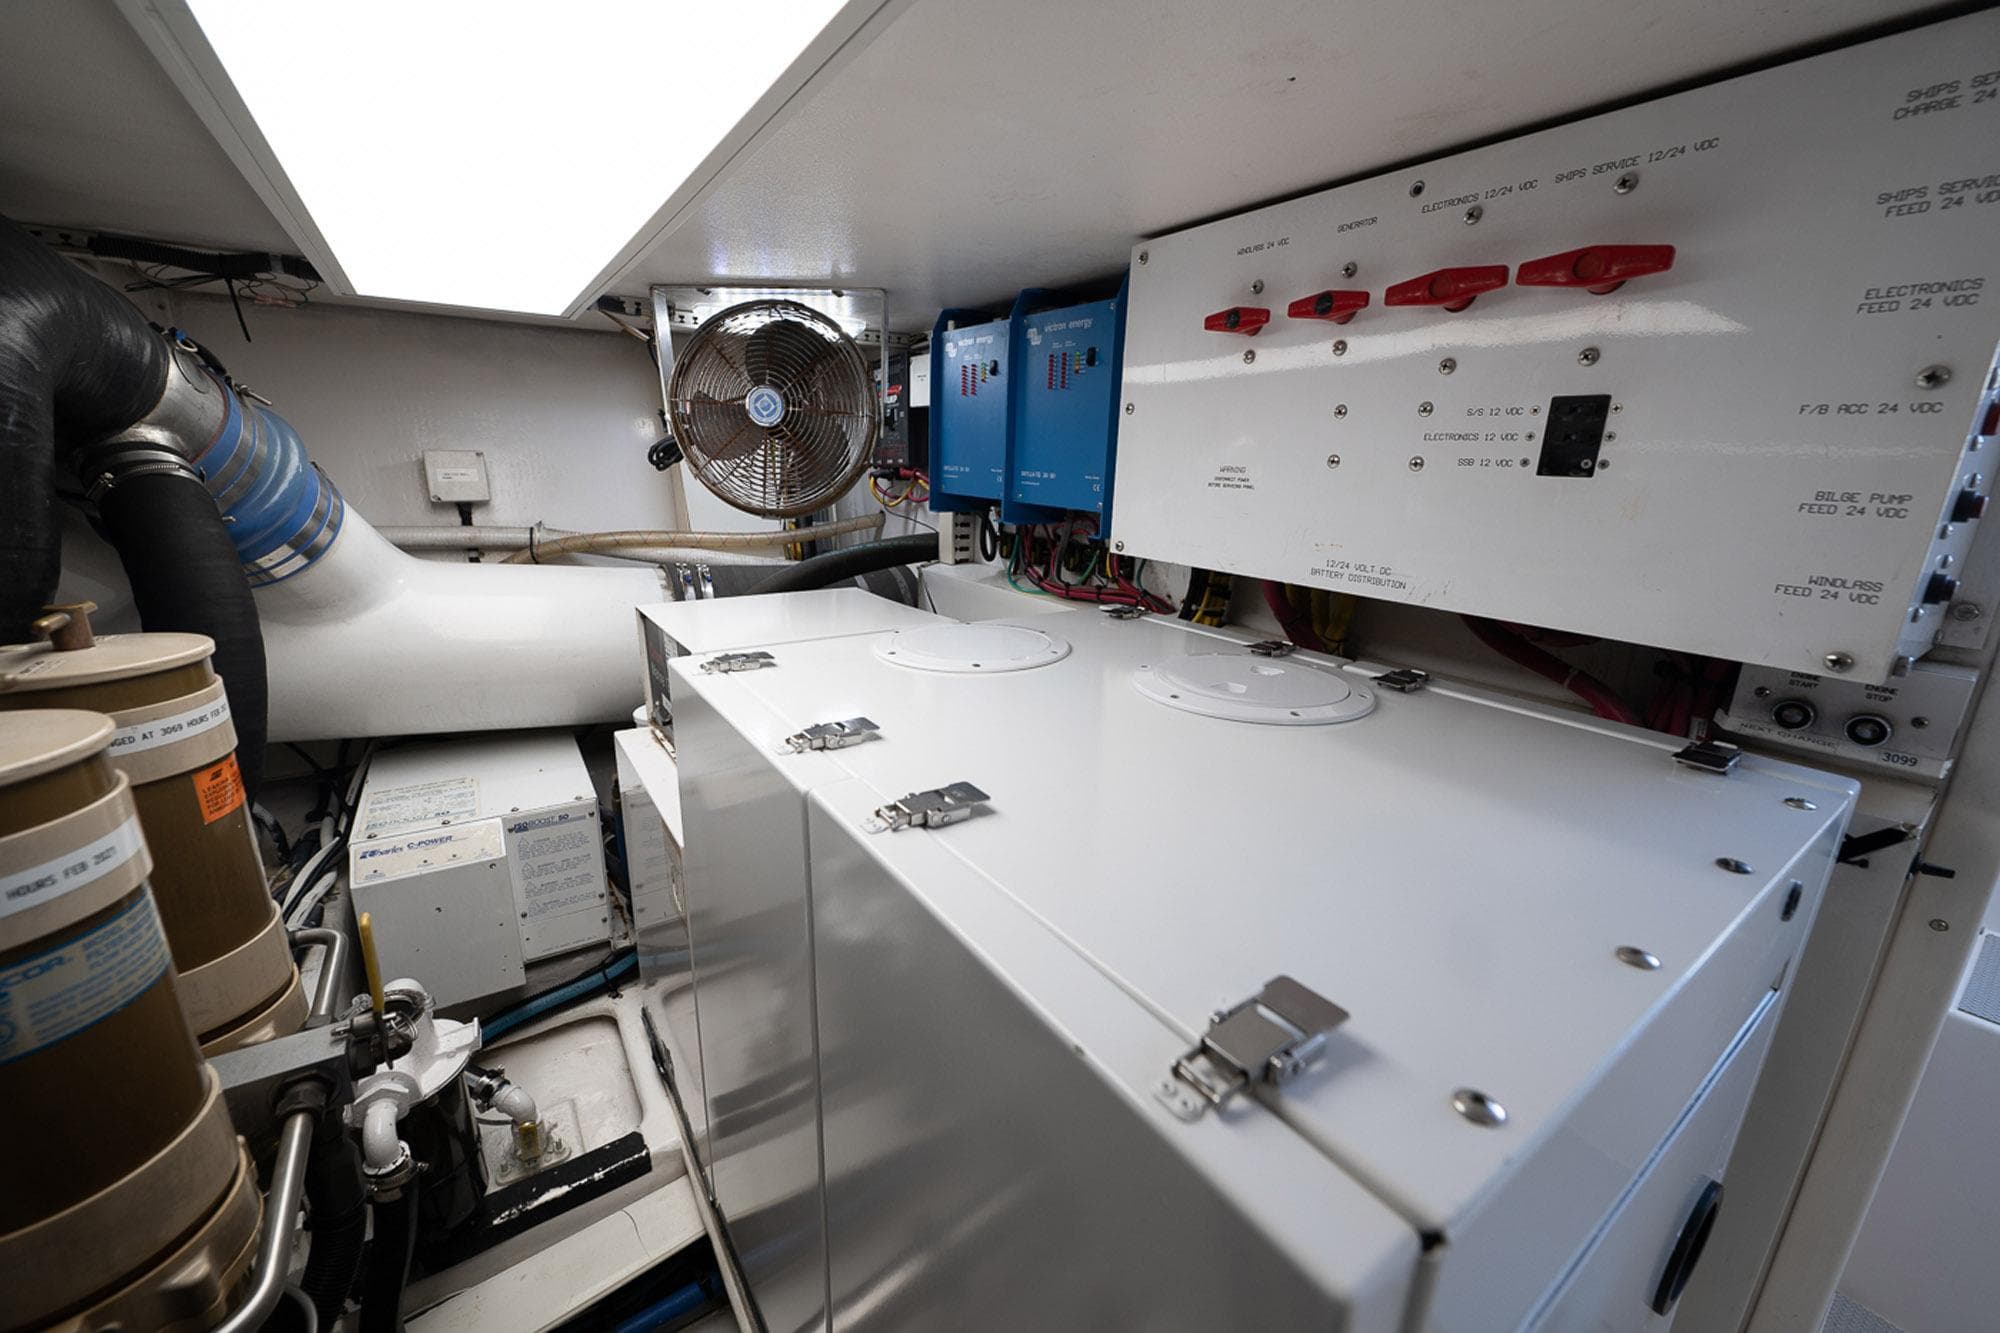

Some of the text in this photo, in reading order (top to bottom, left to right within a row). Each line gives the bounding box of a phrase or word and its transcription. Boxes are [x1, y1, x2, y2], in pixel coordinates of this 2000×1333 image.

[1906, 80, 1961, 103] SHIPS
[1894, 88, 1998, 120] CHARGE 24
[1555, 137, 1720, 184] SHIPS SERVICE 12/24 VDC
[1421, 180, 1538, 213] ELECTRONICS 12/24 VDC
[1876, 185, 1929, 205] SHIPS
[1884, 200, 1931, 218] FEED
[1941, 196, 1964, 210] 24
[1864, 277, 1986, 300] ELECTRONICS
[1857, 293, 1980, 314] FEED 24 VDC
[1069, 317, 1093, 329] energy
[1466, 407, 1524, 417] S/S 12 VDC
[1799, 402, 1944, 415] F/B ACC 24 VDC
[1424, 432, 1519, 442] ELECTRONICS 12 VDC
[1457, 458, 1513, 468] SSB 12 VDC
[1815, 491, 1913, 505] BILGE PUMP
[1798, 503, 1908, 519] FEED 24 VDC
[1326, 560, 1392, 576] 12/24 VOLT DC
[1311, 567, 1407, 590] BATTERY DISTRIBUTION
[1808, 575, 1884, 593] WINDLASS
[1774, 584, 1880, 605] FEED 24 VDC
[1789, 679, 1819, 689] START
[1865, 684, 1899, 696] ENGINE
[1865, 692, 1893, 703] STOP
[141, 731, 154, 741] AT
[187, 714, 209, 728] HOURS
[1883, 752, 1918, 767] 3099
[6, 874, 58, 900] HOURS
